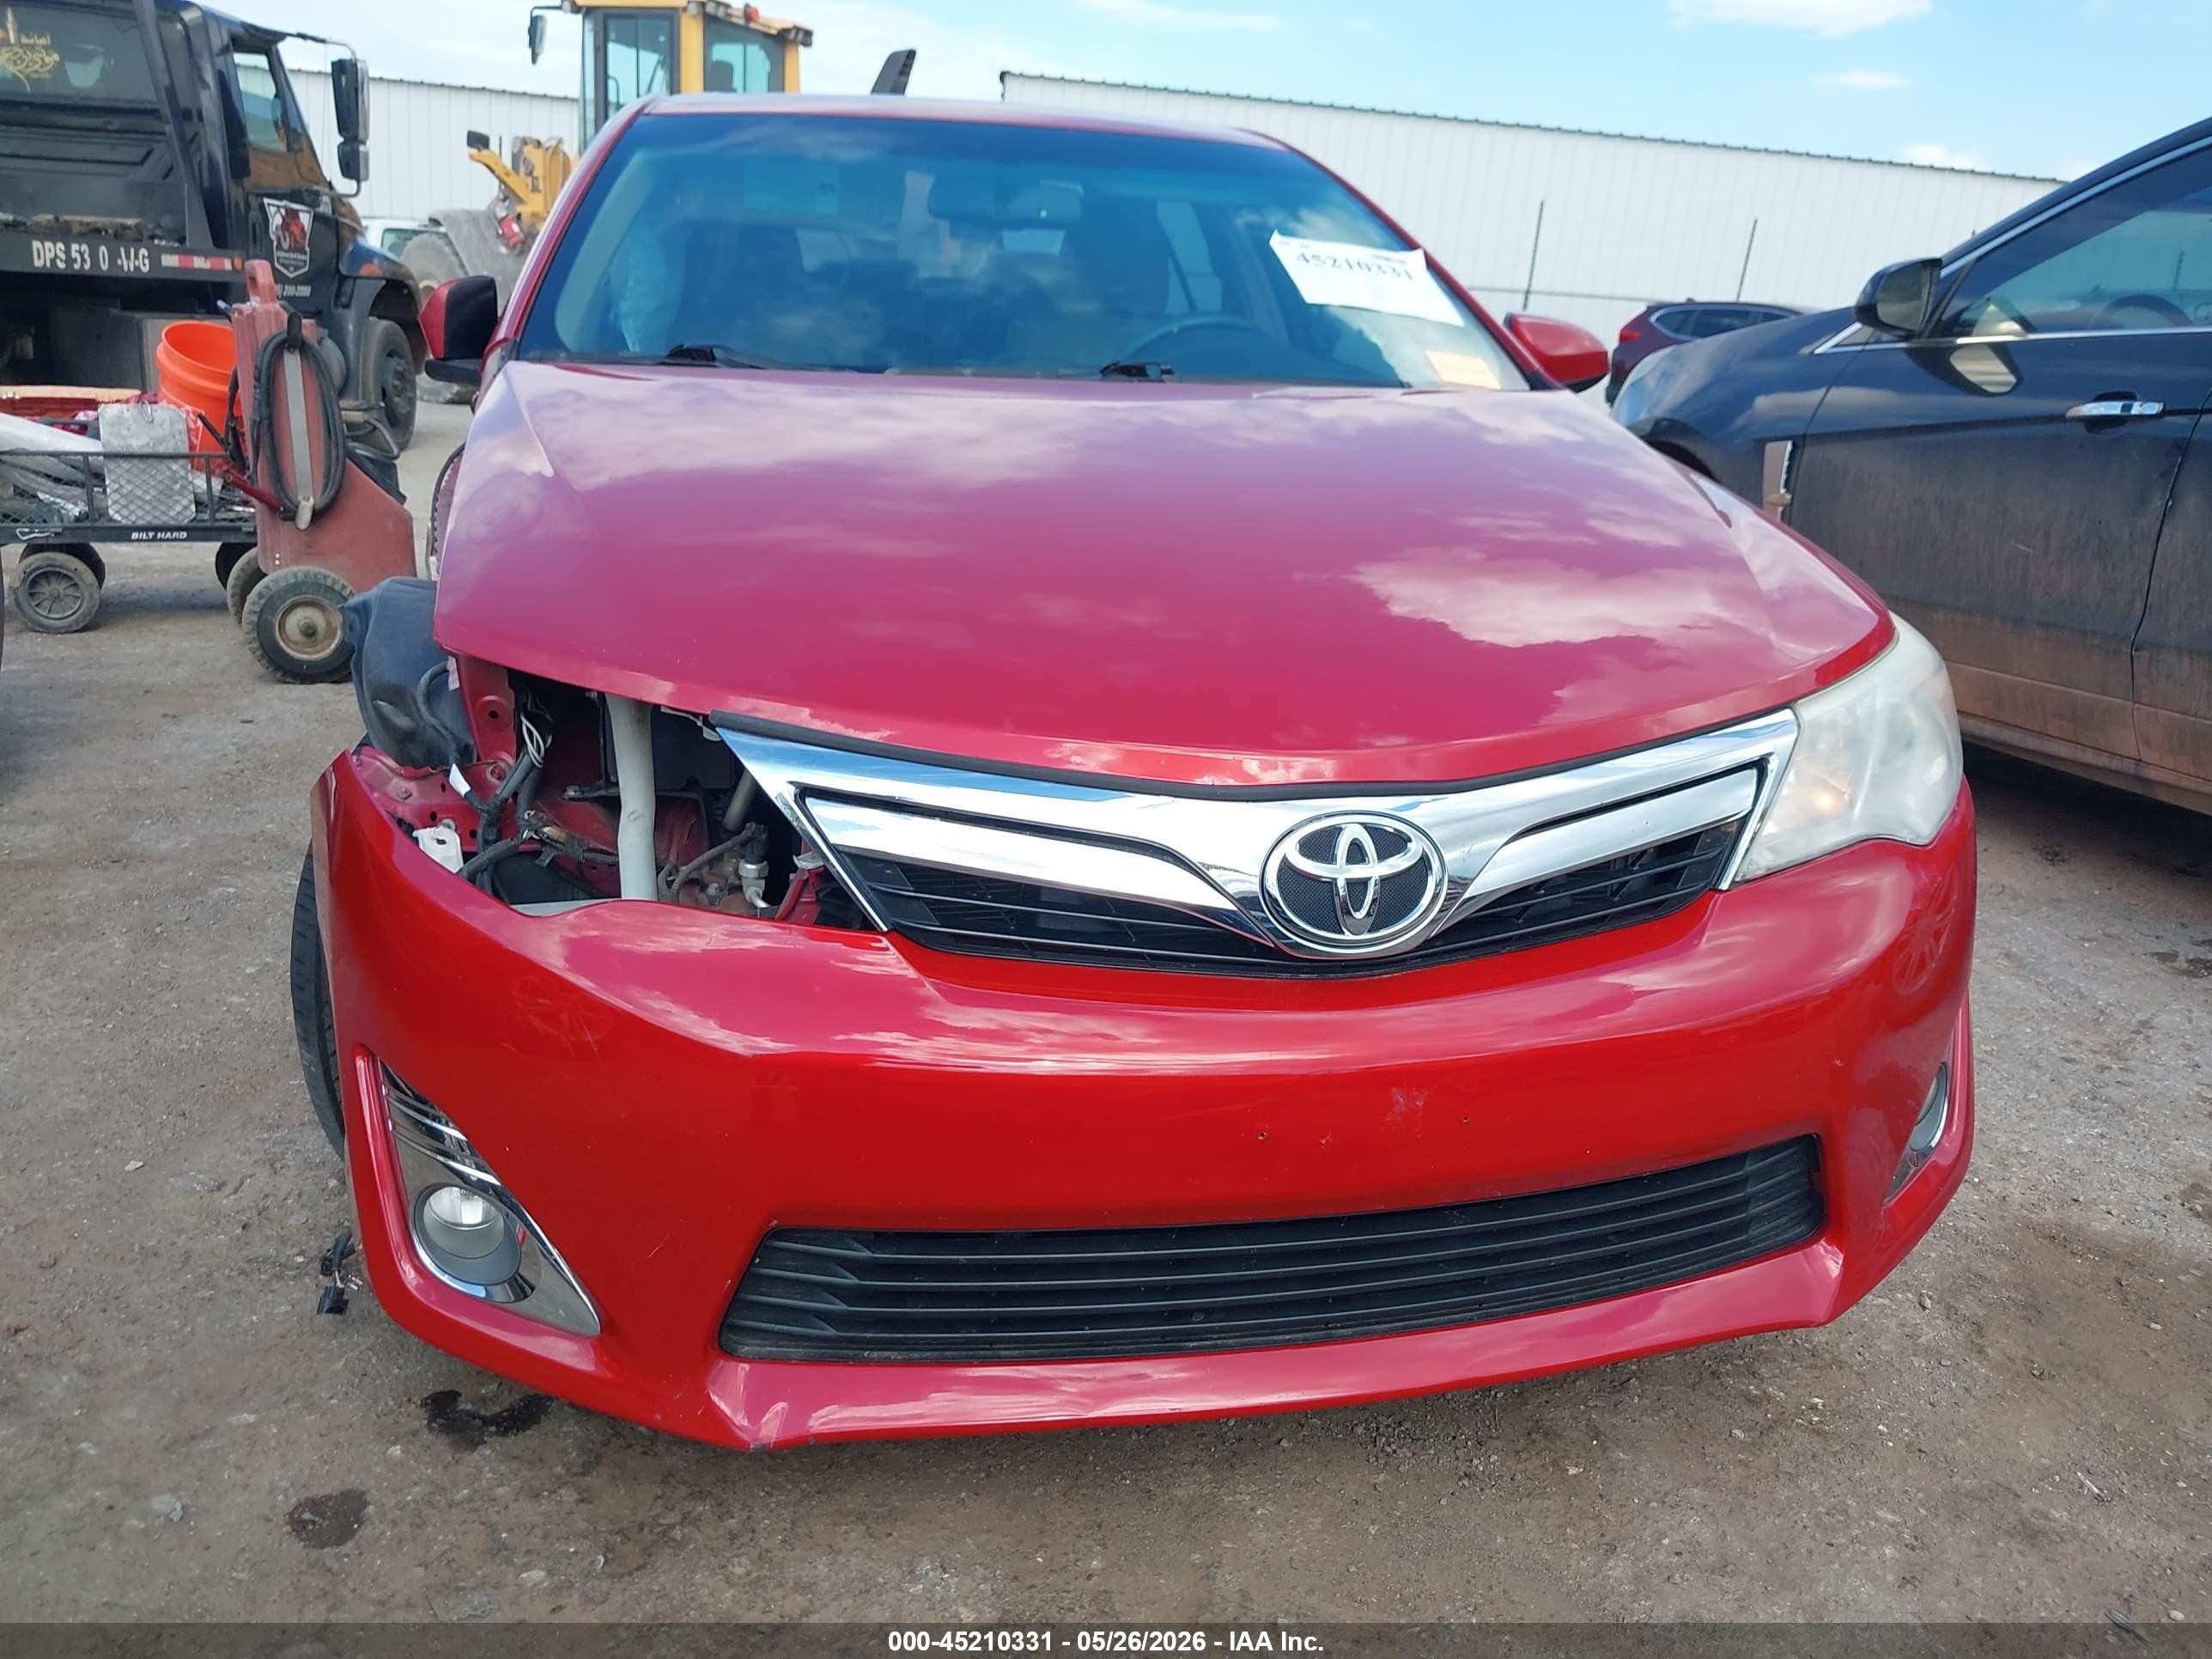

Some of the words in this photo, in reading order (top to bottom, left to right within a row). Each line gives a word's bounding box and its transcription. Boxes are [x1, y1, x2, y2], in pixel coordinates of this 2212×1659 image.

[32, 239, 67, 270] DPS
[131, 531, 155, 541] BILT
[156, 531, 188, 541] HARD
